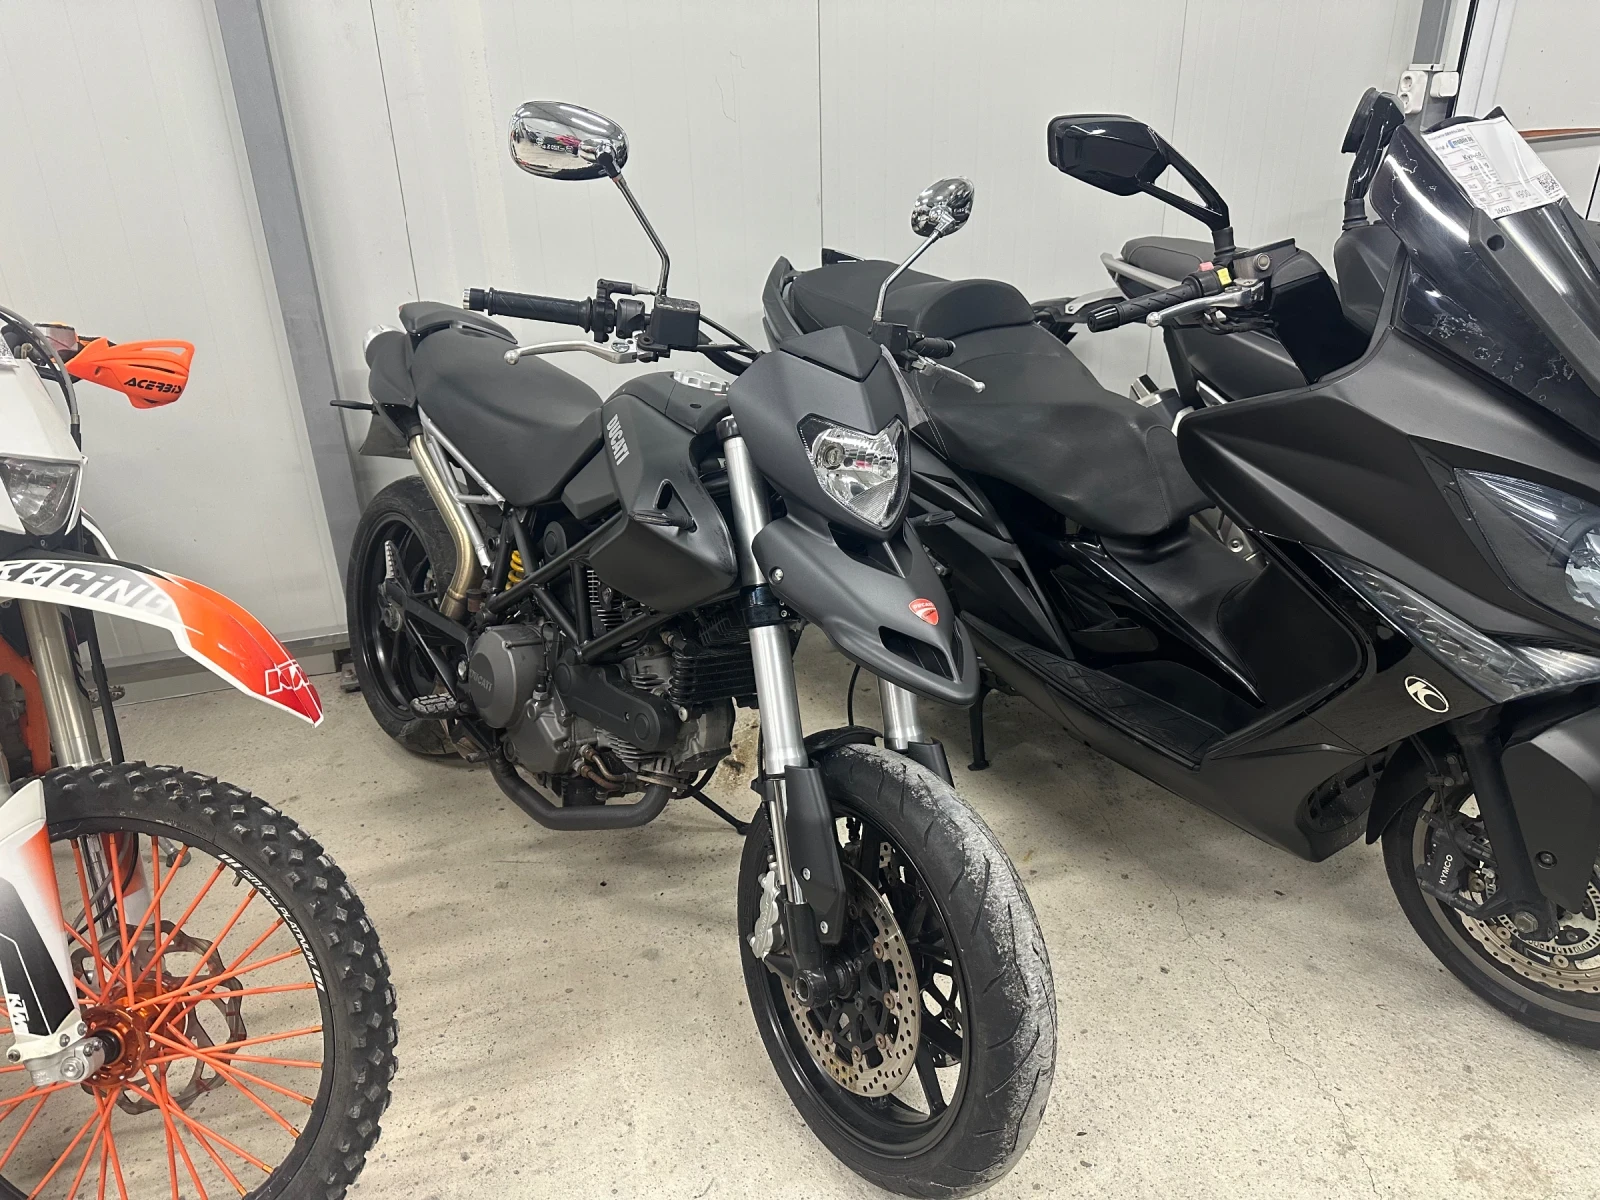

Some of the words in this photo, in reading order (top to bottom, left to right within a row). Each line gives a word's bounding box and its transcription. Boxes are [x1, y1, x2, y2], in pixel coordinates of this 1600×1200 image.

[606, 413, 630, 466] DUCATI
[469, 668, 493, 692] DUCATI
[1439, 854, 1453, 886] KYMCO
[277, 906, 318, 969] PLATINUM
[6, 993, 30, 1034] KTM
